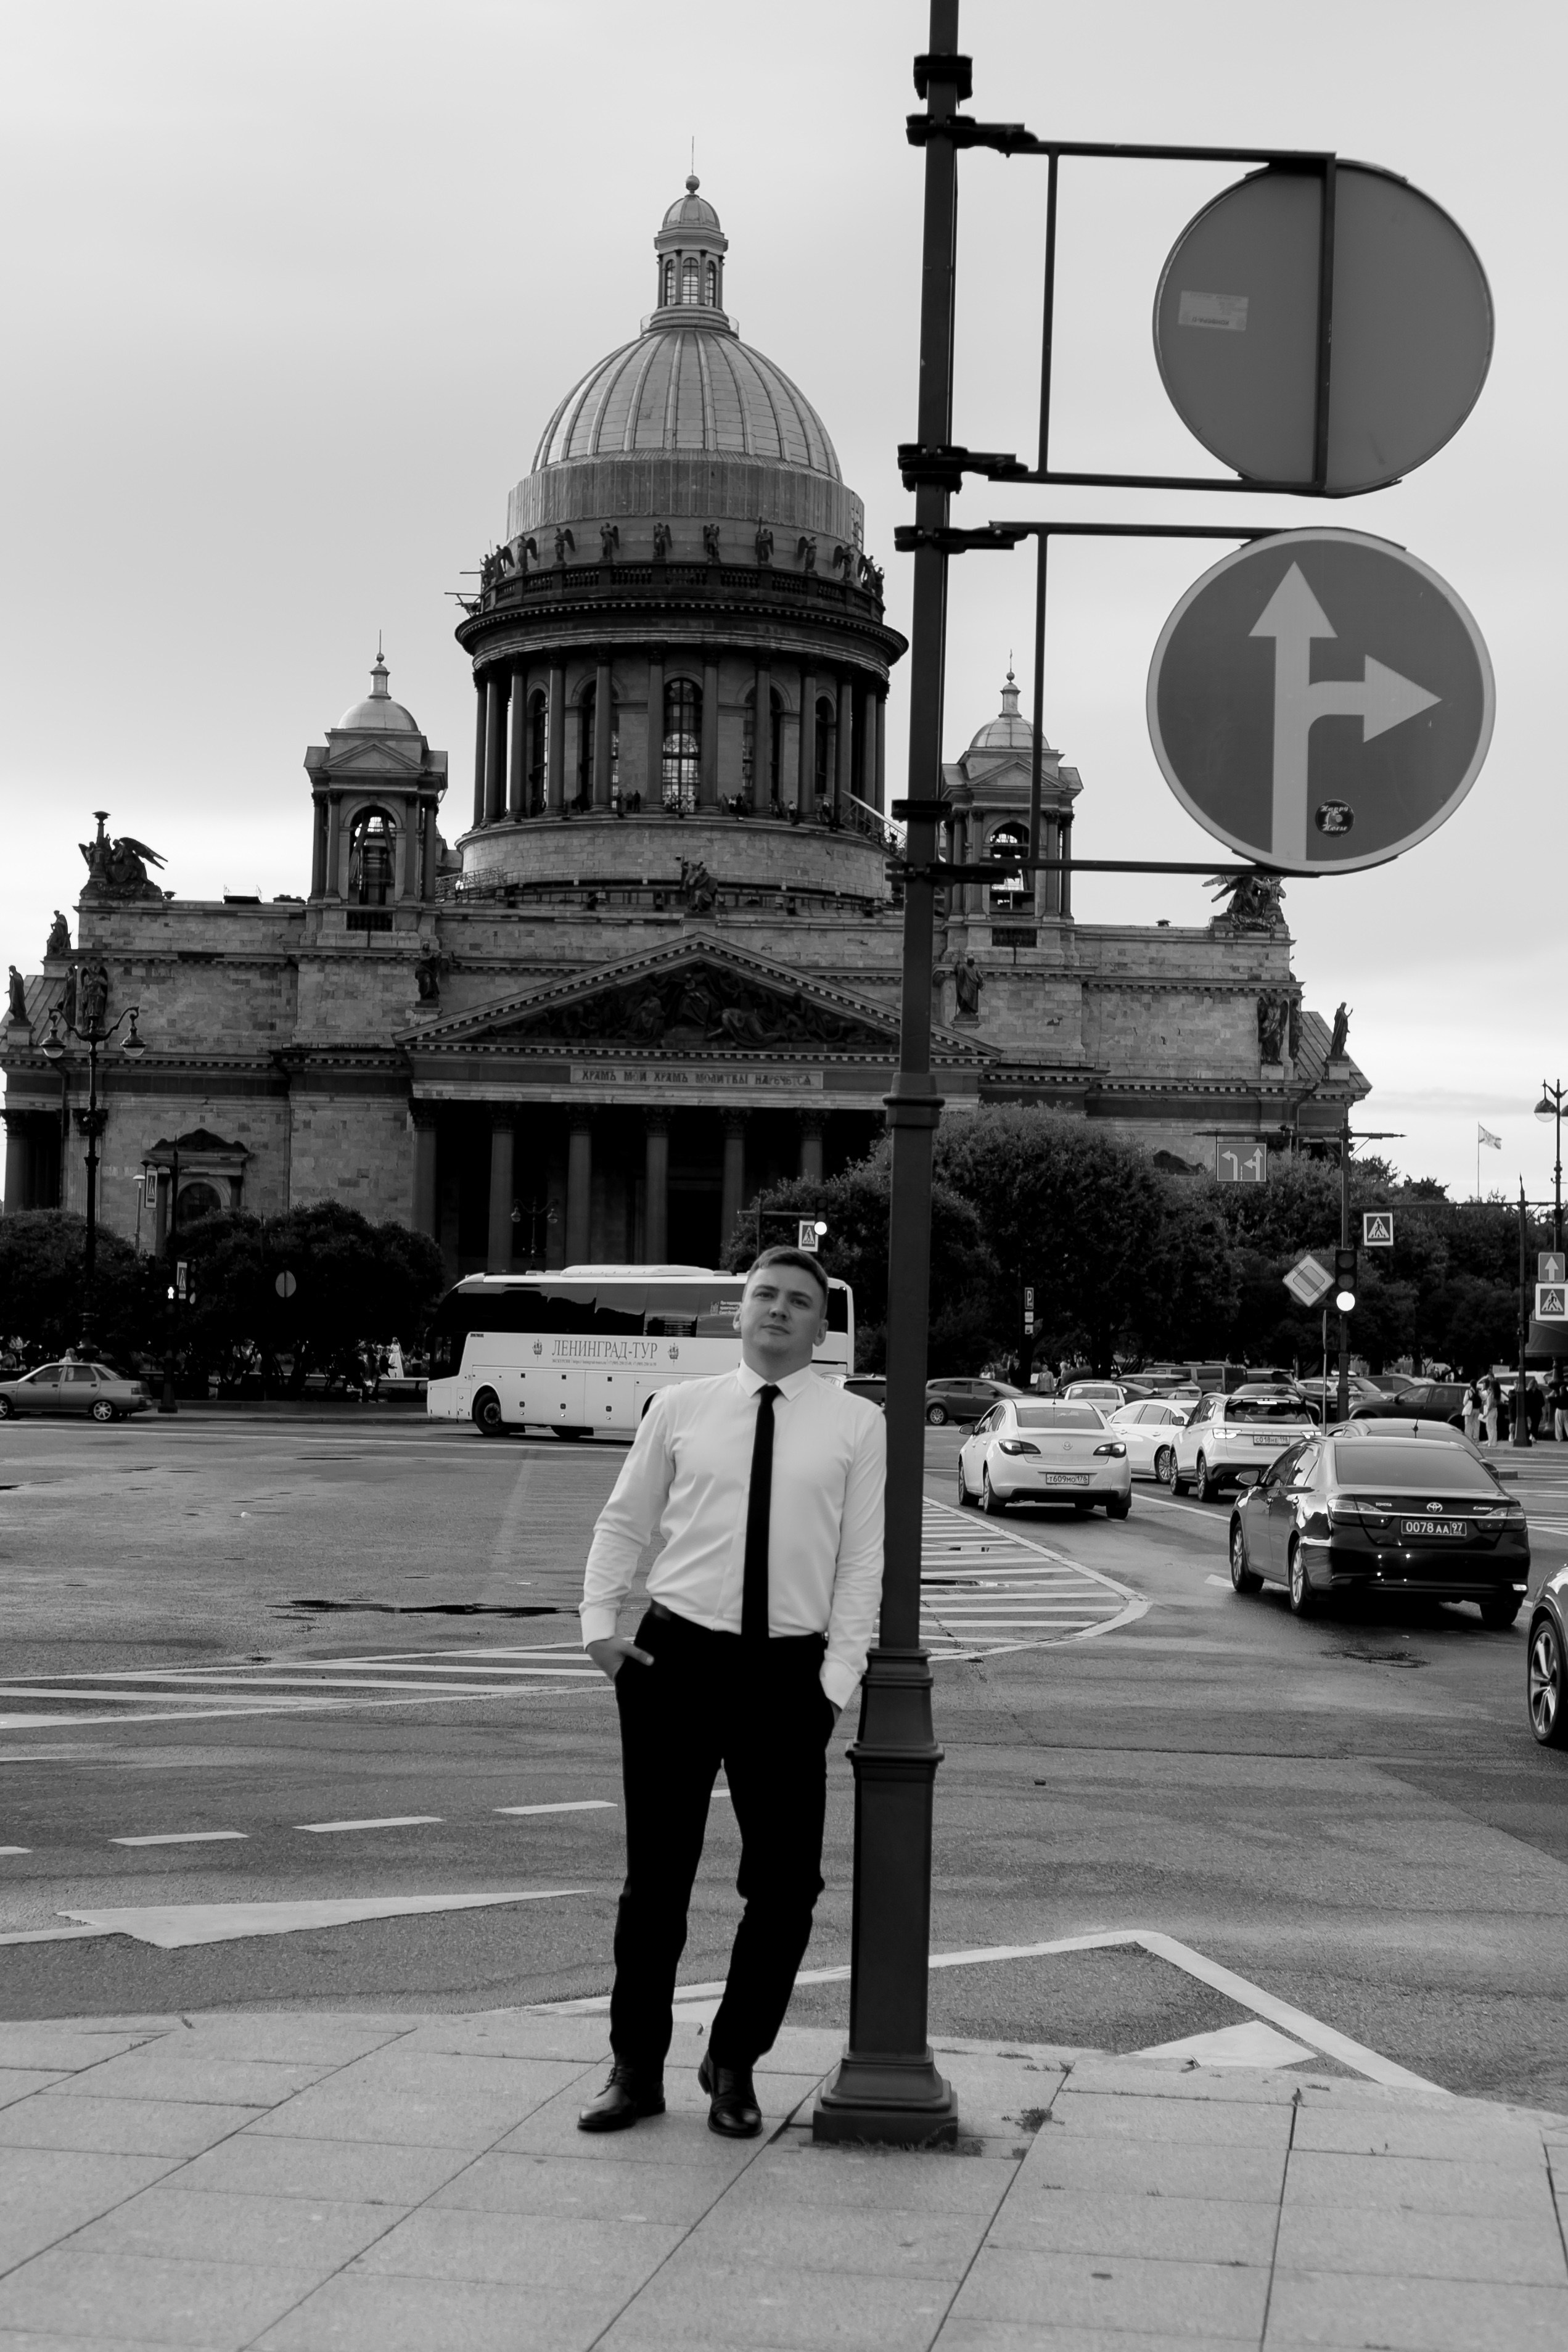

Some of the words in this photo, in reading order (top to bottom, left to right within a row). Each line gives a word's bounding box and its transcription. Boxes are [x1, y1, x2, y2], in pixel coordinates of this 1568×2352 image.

[581, 1070, 616, 1080] ХРАМЪ
[654, 1072, 689, 1083] ХРАМЪ
[552, 1339, 658, 1360] ЛЕНИНГРАД-ТУР
[1451, 1523, 1463, 1531] 97
